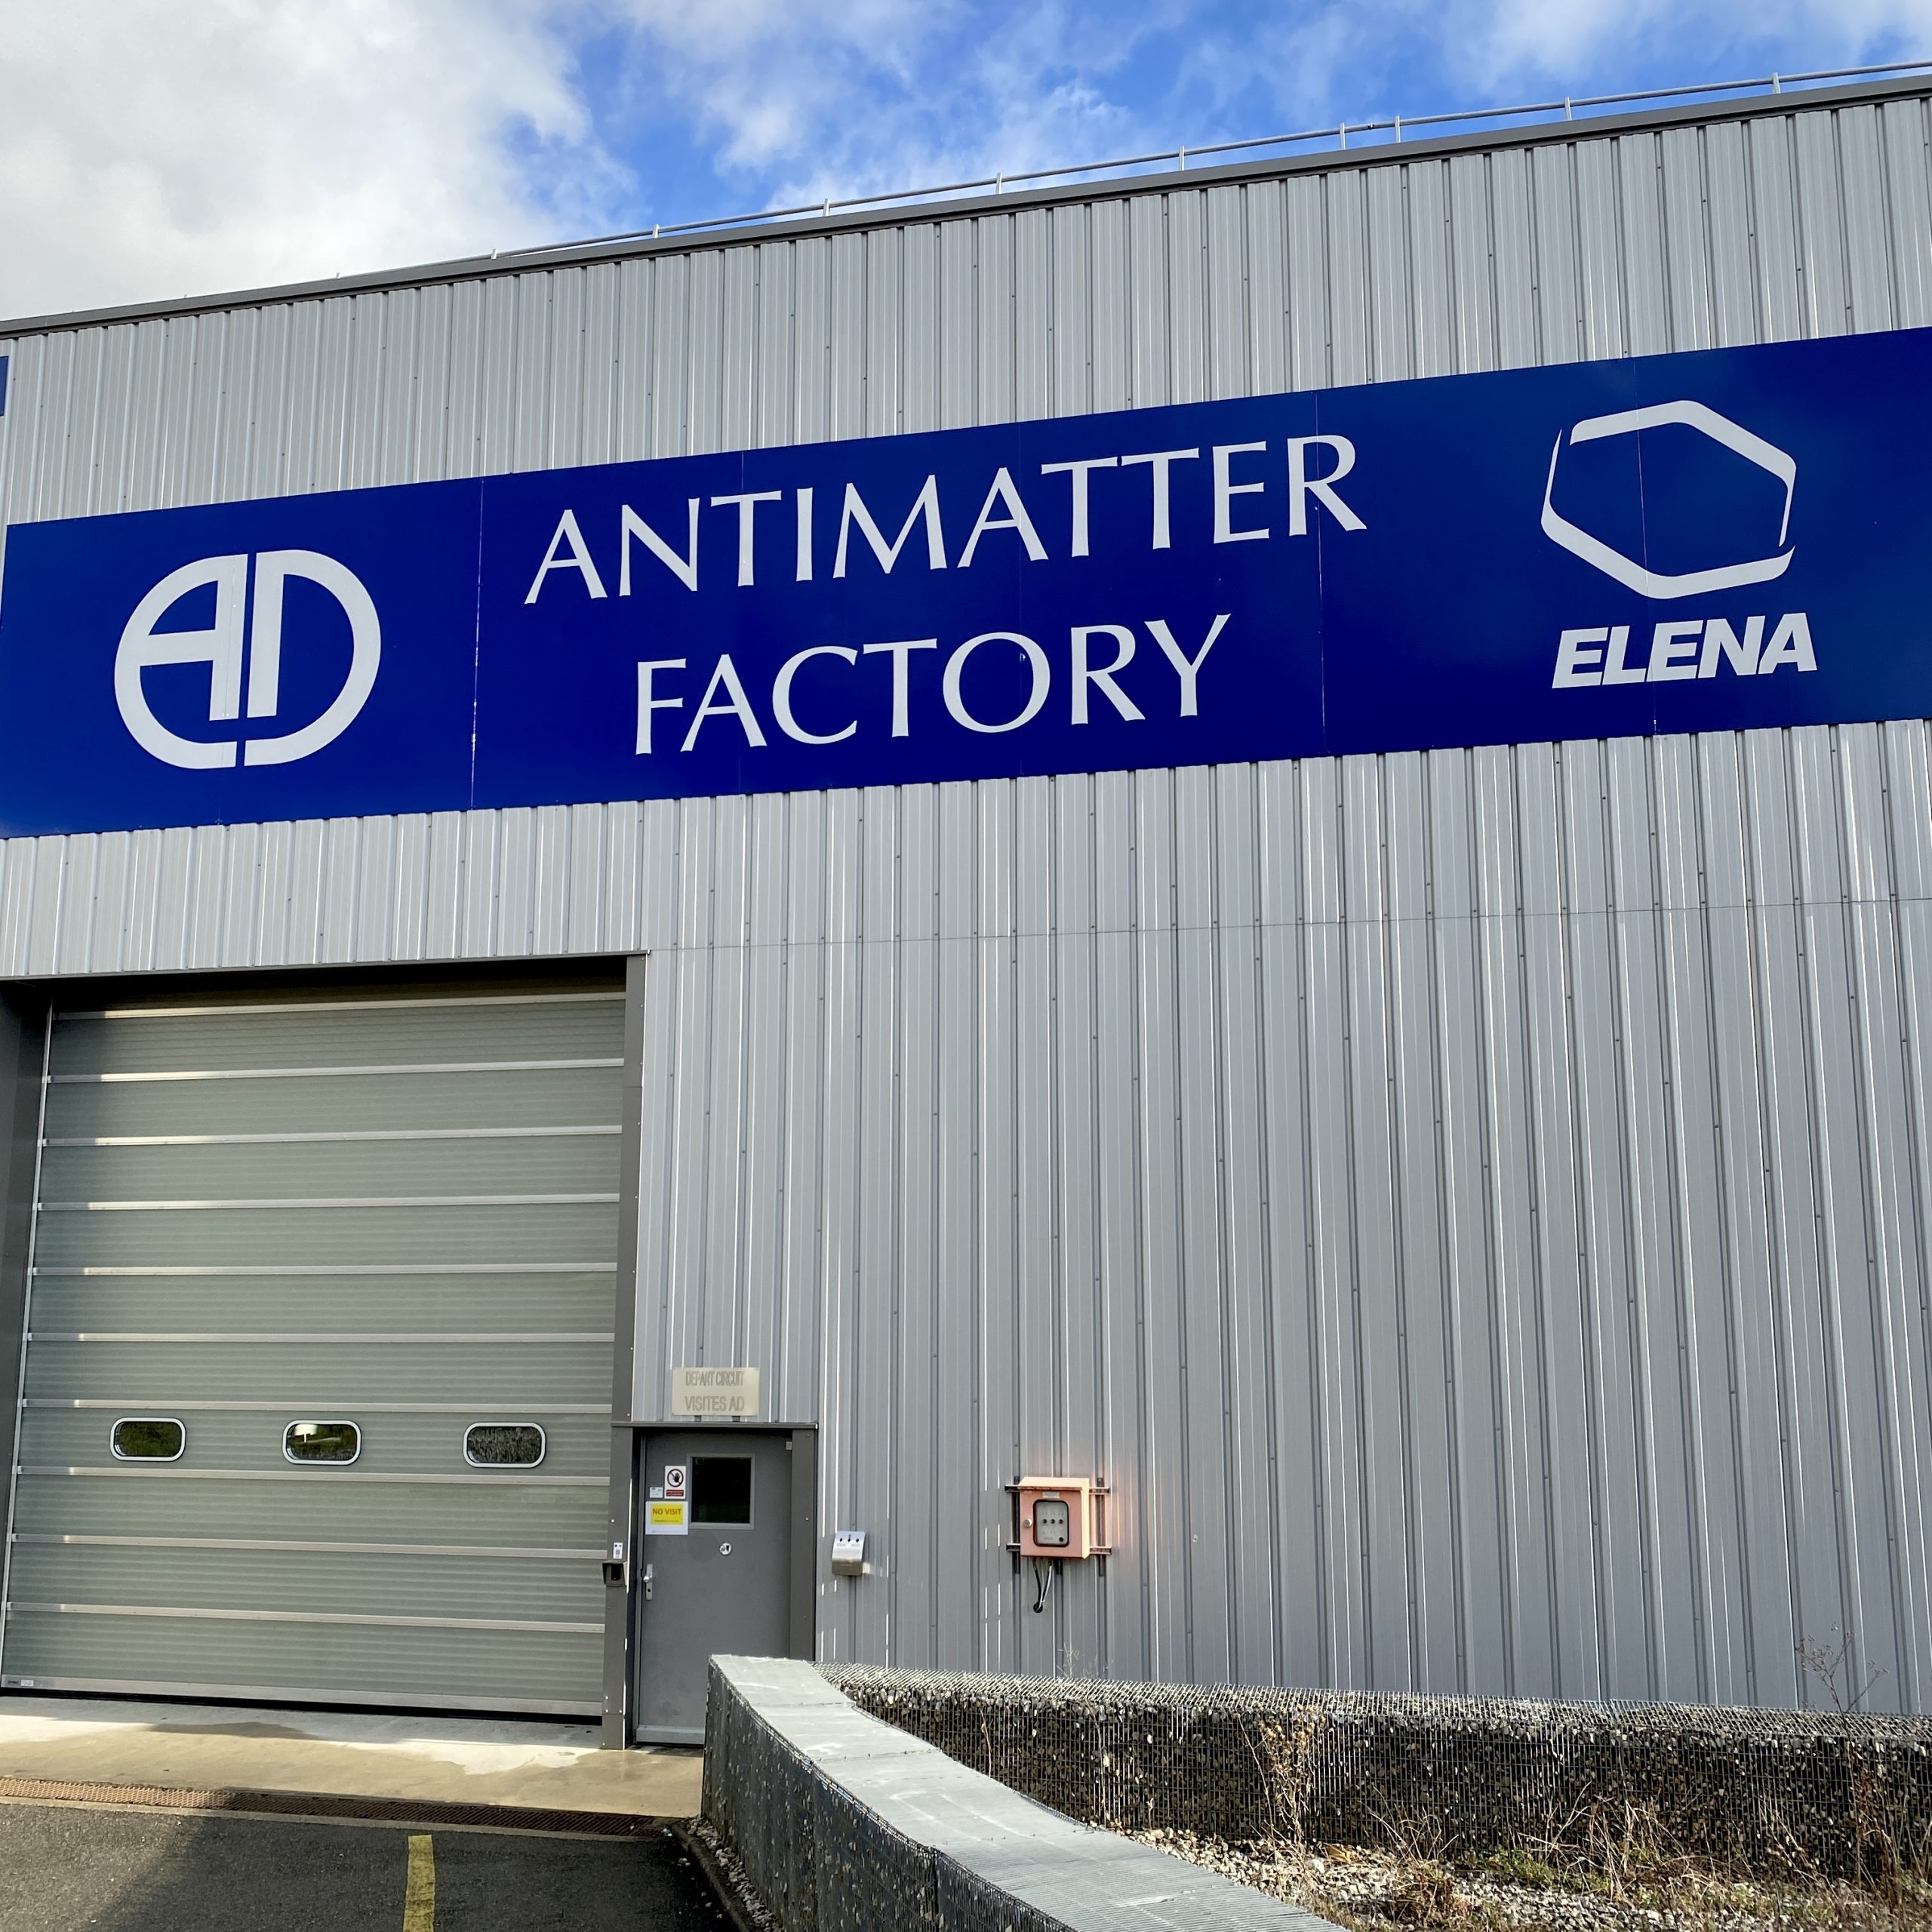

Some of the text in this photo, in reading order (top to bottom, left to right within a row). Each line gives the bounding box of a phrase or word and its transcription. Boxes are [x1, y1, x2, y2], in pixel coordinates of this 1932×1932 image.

[525, 435, 1367, 605] ANTIMATTER
[635, 614, 1231, 755] FACTORY
[1552, 612, 1818, 689] ELENA
[685, 1396, 745, 1411] VISITES AD
[715, 1371, 745, 1386] CIRCUIT
